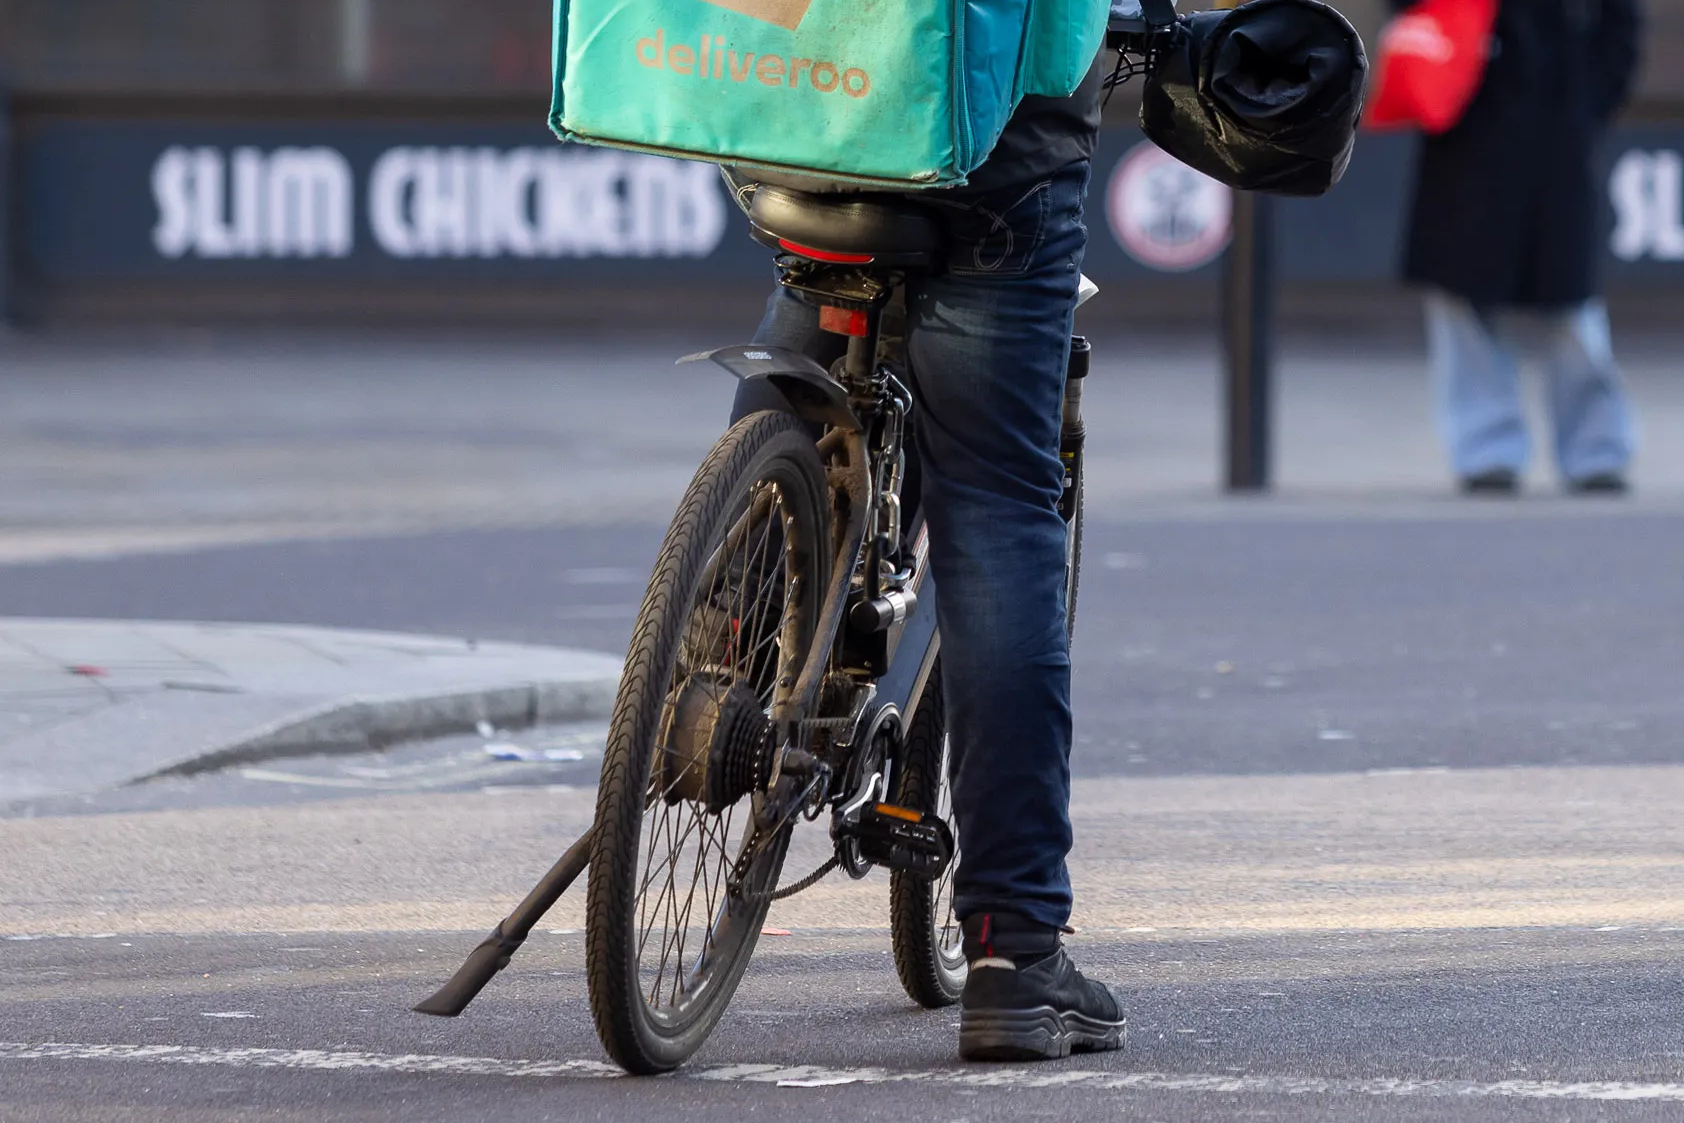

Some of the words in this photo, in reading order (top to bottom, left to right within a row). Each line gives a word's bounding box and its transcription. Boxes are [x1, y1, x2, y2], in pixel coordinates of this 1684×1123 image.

[635, 28, 871, 98] deliveroo
[153, 144, 353, 258] SLIM
[368, 144, 727, 258] CHICKENS
